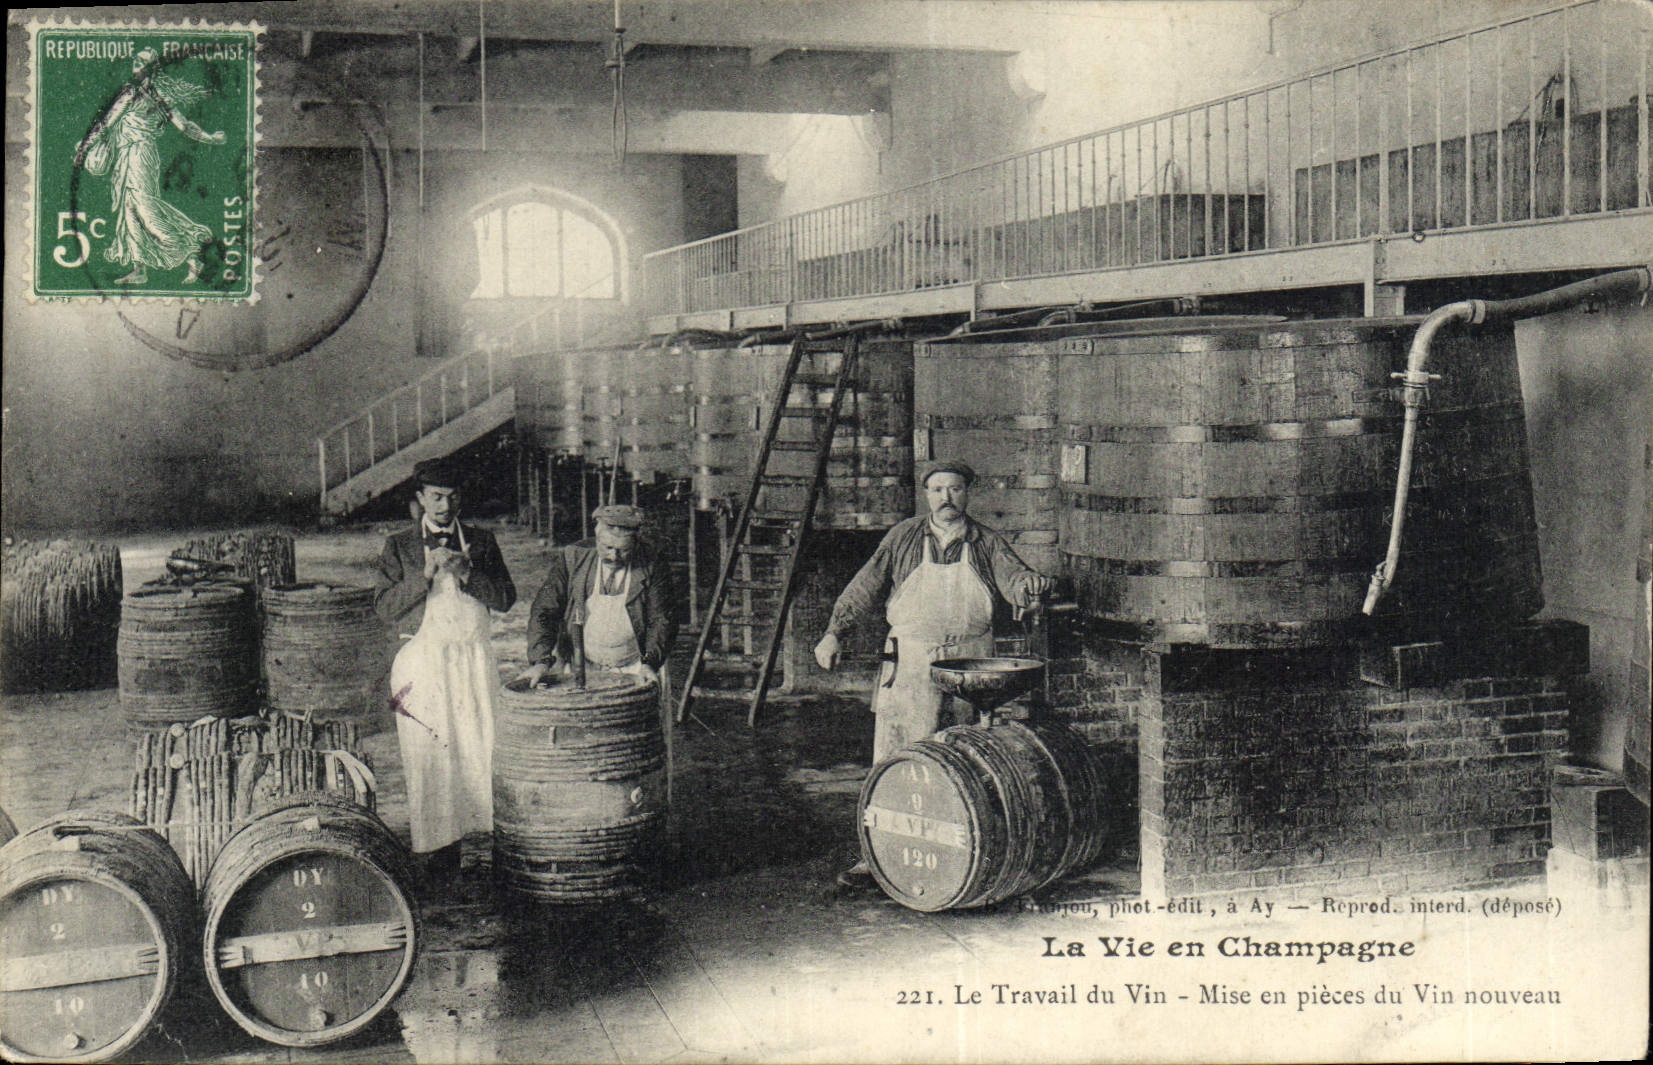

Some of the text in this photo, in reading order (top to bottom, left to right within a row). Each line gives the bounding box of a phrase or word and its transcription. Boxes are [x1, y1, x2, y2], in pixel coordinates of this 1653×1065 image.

[223, 195, 243, 282] POSTES
[902, 847, 937, 870] 120
[301, 901, 316, 919] 2
[50, 922, 66, 940] 2
[301, 971, 328, 990] 10
[55, 996, 84, 1015] 10
